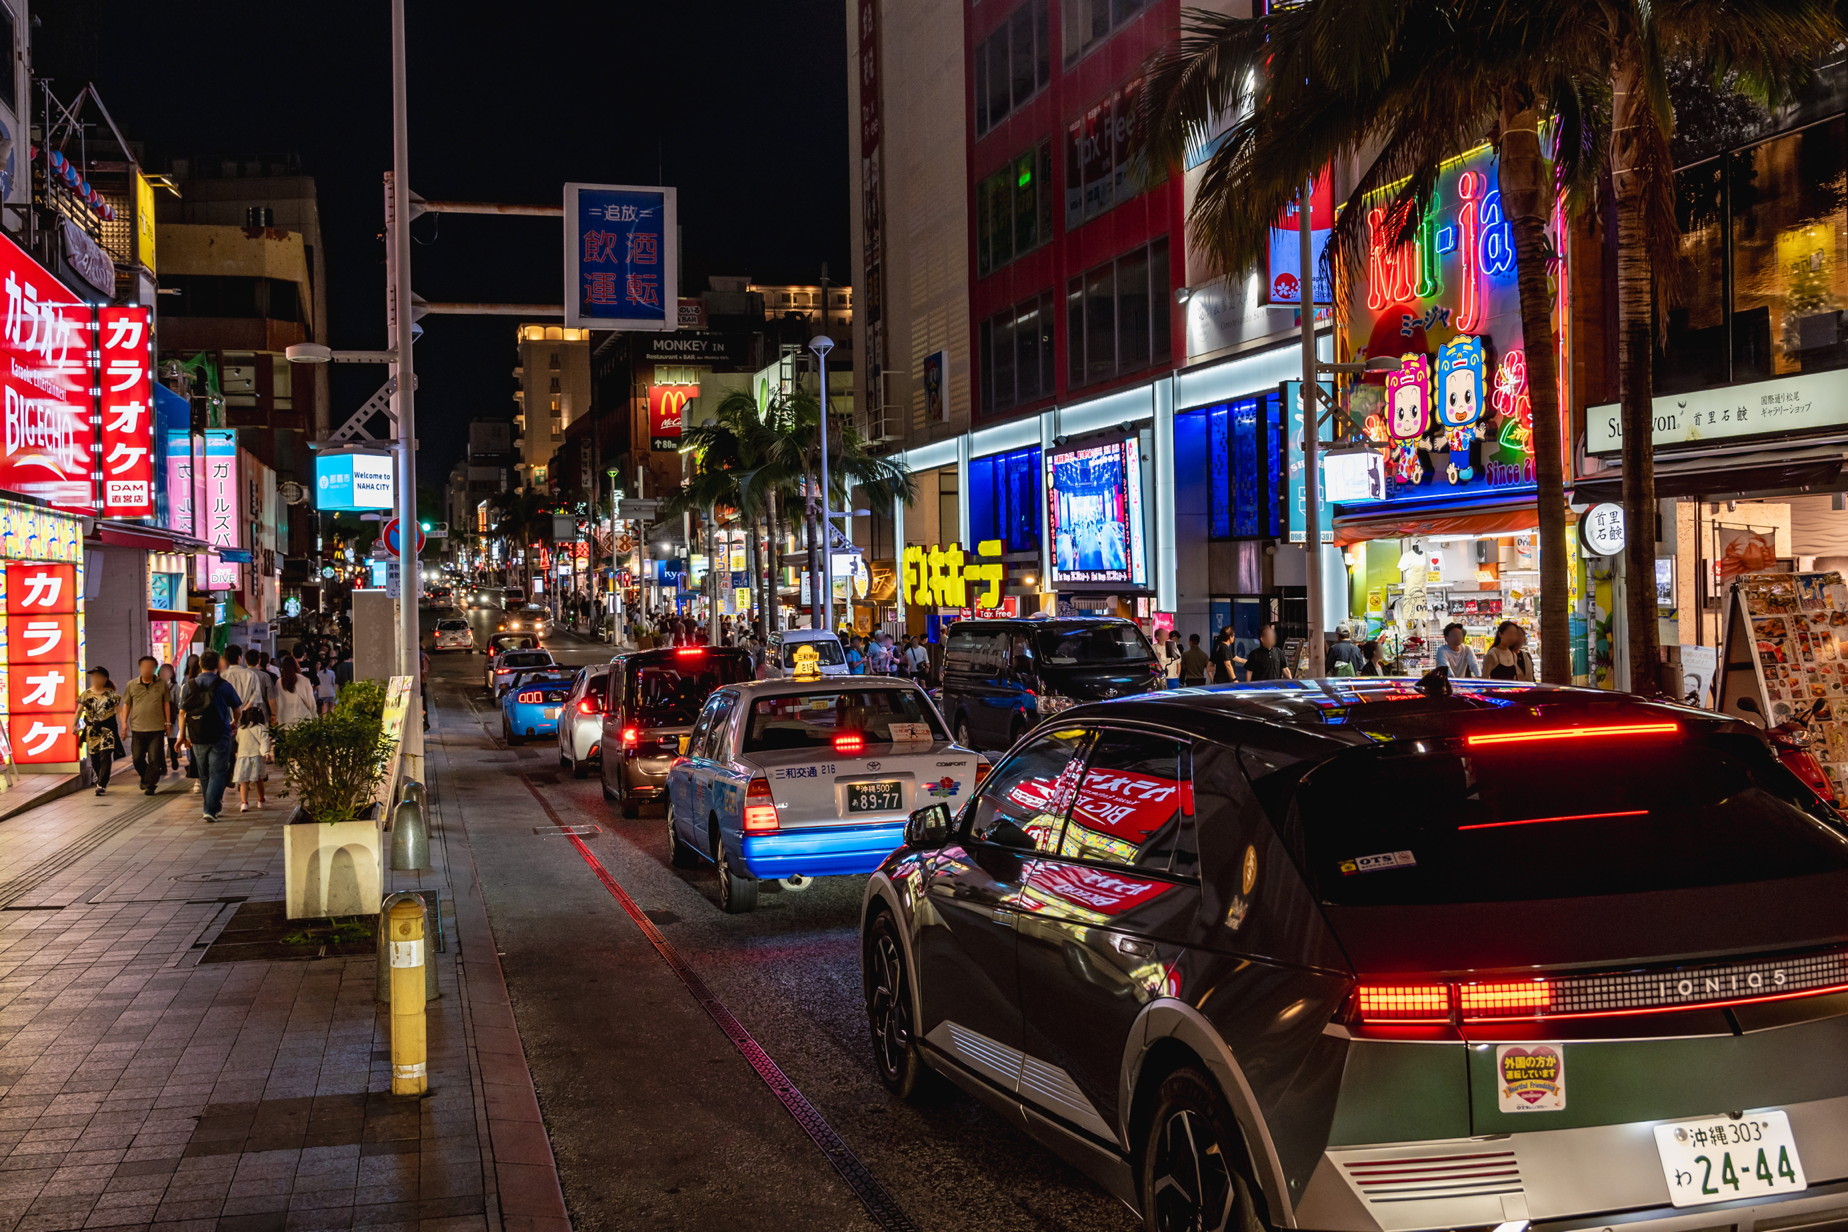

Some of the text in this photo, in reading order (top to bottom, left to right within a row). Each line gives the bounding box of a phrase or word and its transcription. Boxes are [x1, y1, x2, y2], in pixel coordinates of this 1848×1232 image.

[1074, 110, 1137, 170] Tax Fee
[603, 203, 638, 222] 追放
[583, 229, 658, 265] 飲酒
[583, 272, 660, 306] 運転
[5, 269, 71, 371] カラオケ
[1400, 306, 1453, 337] ミージャ
[653, 339, 725, 352] MONKEY IN
[646, 353, 678, 361] Restaurant
[104, 317, 147, 475] カラオケ
[1760, 390, 1801, 406] 国際通り松尾
[1760, 401, 1812, 418] ギャラリーショップ
[354, 471, 391, 480] Welcome to
[1485, 460, 1520, 488] Since
[110, 484, 144, 493] DAM
[356, 482, 391, 491] NAHA CITY
[110, 494, 145, 504] 直営店
[1595, 510, 1621, 526] 首里
[210, 574, 237, 584] DIVE
[980, 609, 1012, 618] Tax Free
[20, 572, 67, 757] カラオケ
[802, 663, 814, 672] 216
[775, 764, 836, 780] 三和交通 216
[936, 760, 967, 768] COMFORT
[851, 798, 860, 807] あ
[860, 792, 901, 810] 89-77
[1359, 854, 1392, 866] OTS
[1659, 969, 1786, 997] IONIQ 5
[1504, 1054, 1558, 1070] 外国の方が
[1505, 1068, 1557, 1080] 運転しています
[1694, 1144, 1797, 1195] 24-44
[1675, 1168, 1693, 1188] わ
